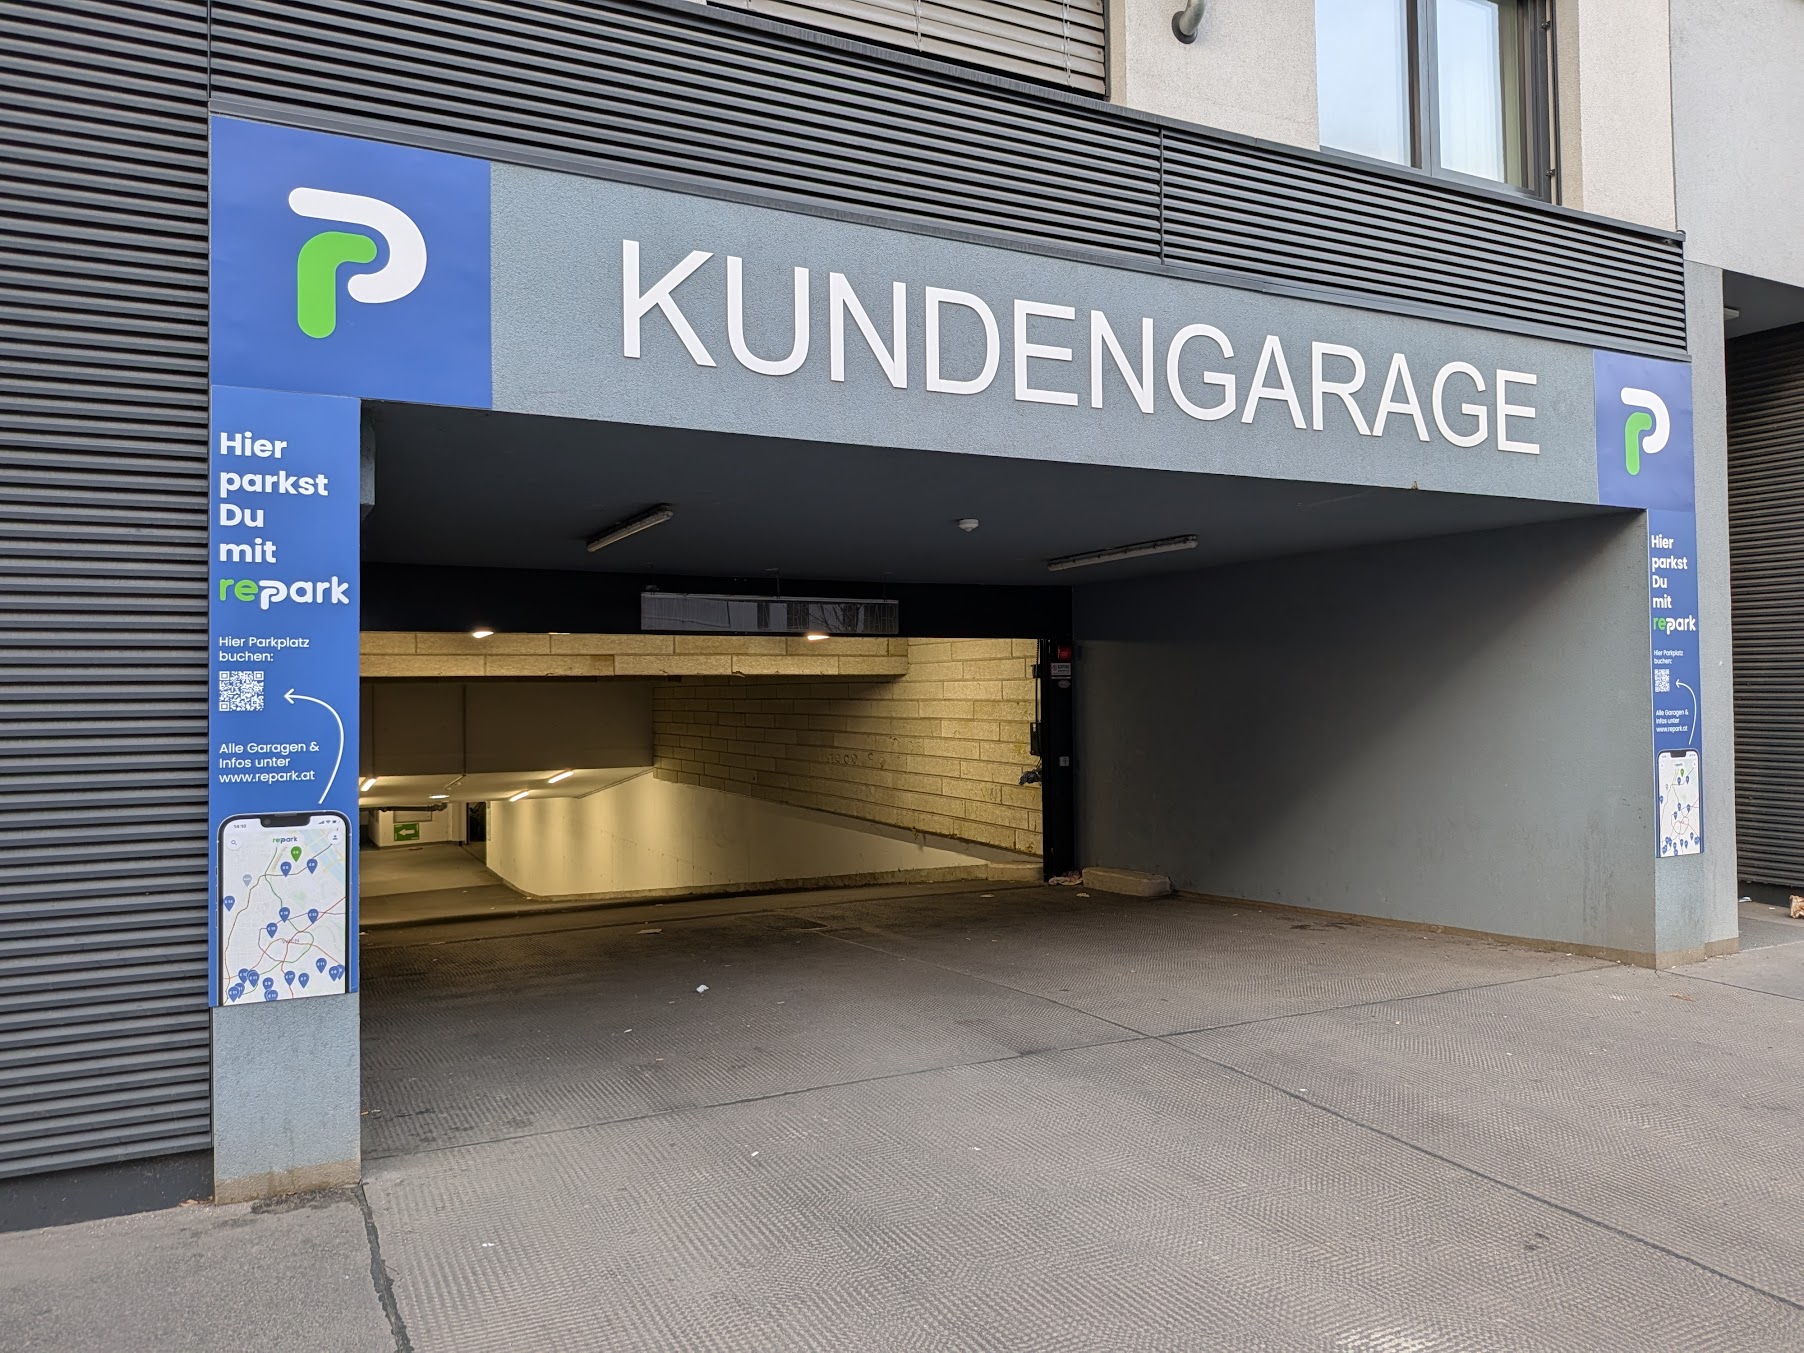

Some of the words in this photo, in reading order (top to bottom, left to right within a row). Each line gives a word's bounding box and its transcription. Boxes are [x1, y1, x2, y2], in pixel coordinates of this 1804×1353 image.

[620, 238, 1541, 455] KUNDENGARAGE
[220, 431, 288, 459] Hier
[219, 470, 329, 499] parkst
[219, 503, 264, 528] Du
[1651, 533, 1674, 549] Hier
[219, 537, 277, 564] mit
[1651, 555, 1688, 573] parkst
[1652, 574, 1668, 589] Du
[219, 575, 350, 611] repark
[1652, 593, 1672, 609] mit
[1653, 614, 1697, 635] repark
[219, 636, 246, 647] Hier
[249, 636, 310, 650] Parkplatz
[219, 650, 274, 662] buchen:
[1664, 709, 1684, 717] Garagen
[219, 743, 244, 754] Alle
[247, 741, 306, 756] Garagen
[309, 741, 320, 752] &
[219, 757, 252, 769] Infos
[255, 756, 291, 768] unter
[218, 770, 316, 785] www.repark.at
[272, 835, 298, 845] repark
